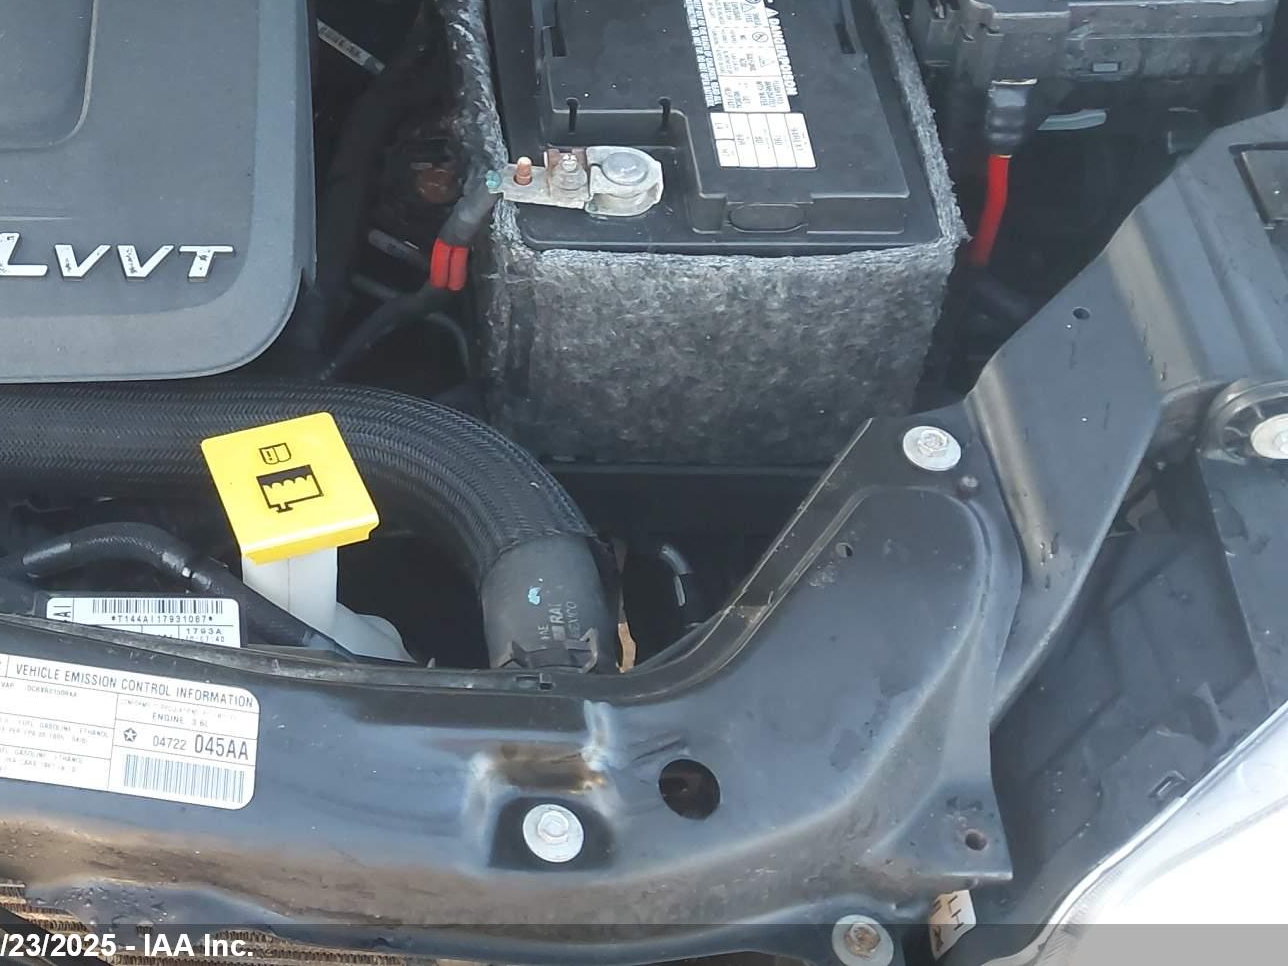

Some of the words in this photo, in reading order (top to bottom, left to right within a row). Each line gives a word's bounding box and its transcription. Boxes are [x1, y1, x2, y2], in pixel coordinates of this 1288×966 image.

[54, 244, 235, 283] VVT
[15, 663, 60, 681] VEHICLE
[64, 670, 118, 689] EMISSION
[121, 678, 173, 697] CONTROL
[175, 686, 254, 709] INFORMATION
[152, 712, 185, 724] ENGINE
[152, 734, 188, 751] 04722
[193, 733, 251, 761] 045AA
